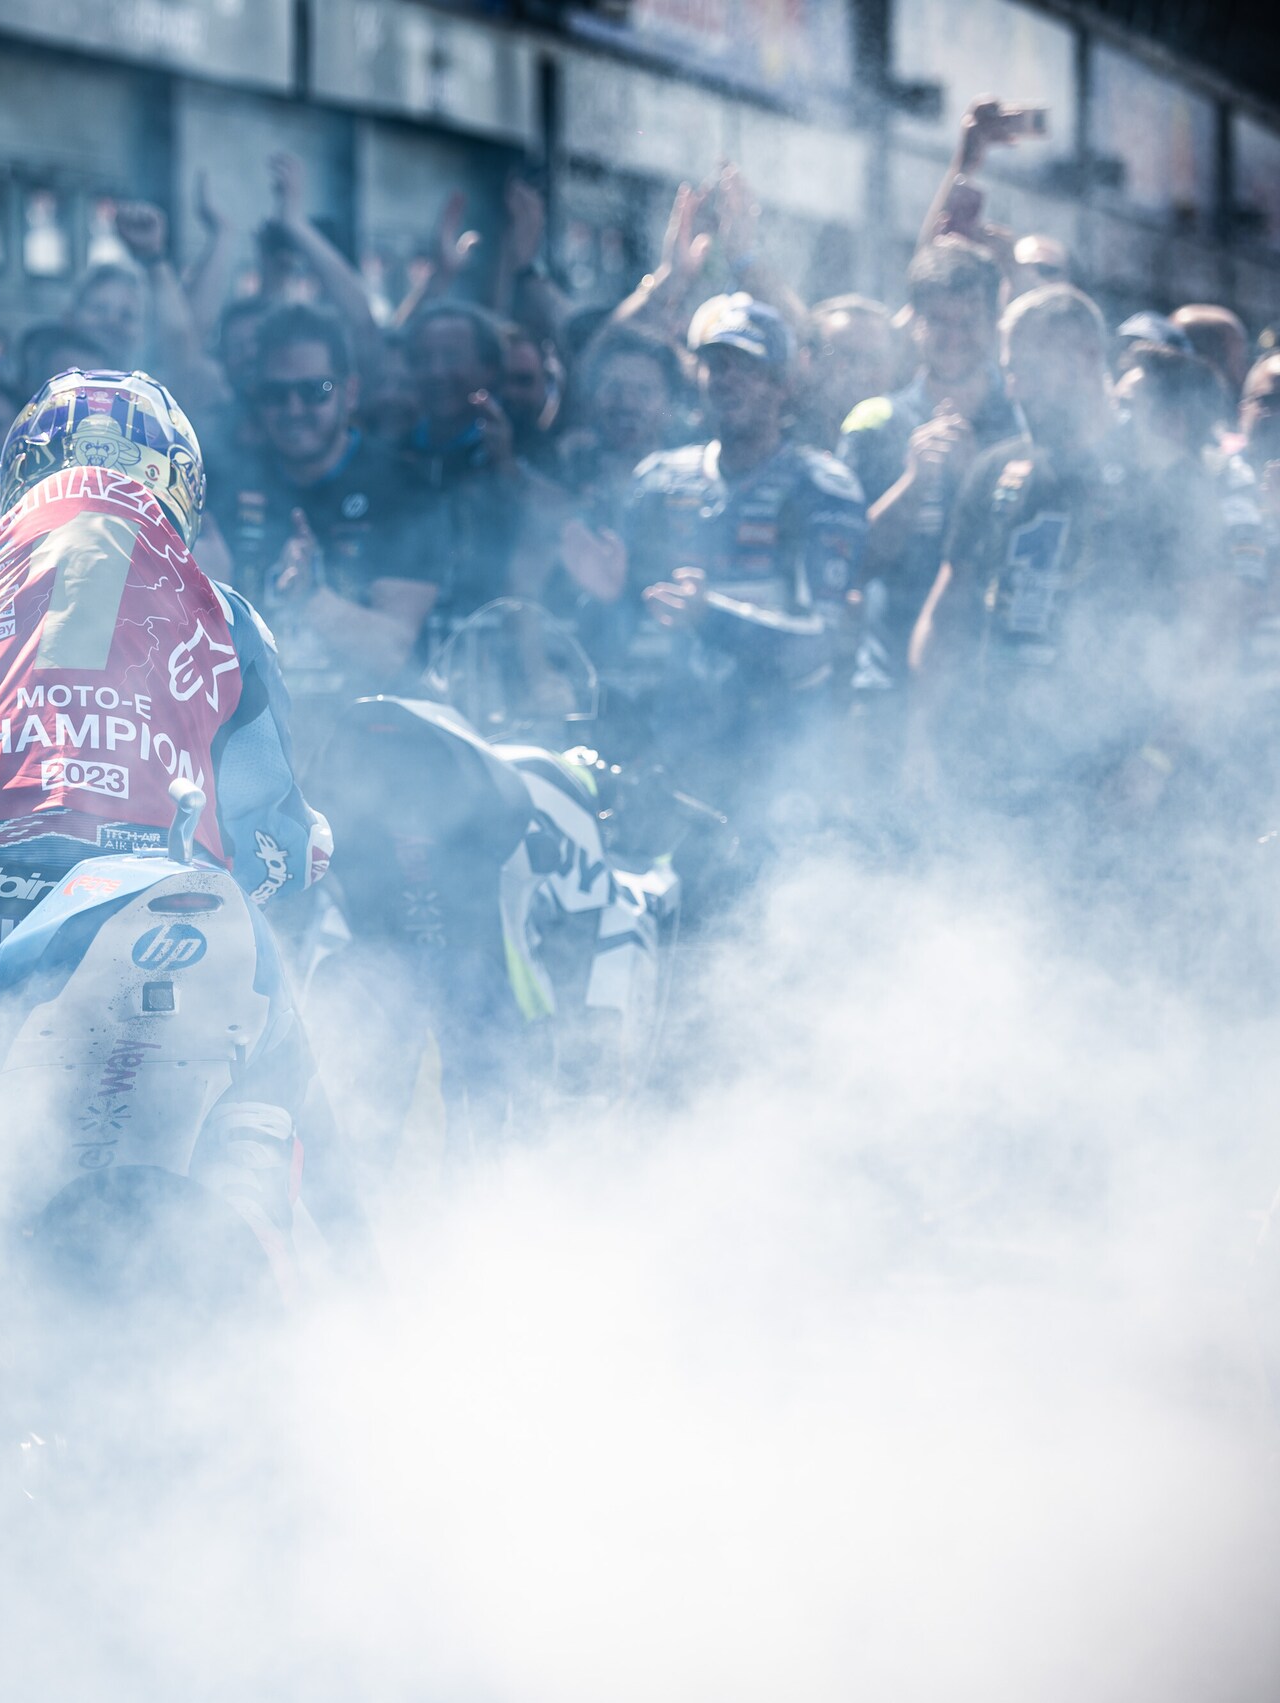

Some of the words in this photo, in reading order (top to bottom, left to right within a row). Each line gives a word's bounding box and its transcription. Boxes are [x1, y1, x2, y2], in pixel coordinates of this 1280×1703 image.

[16, 684, 152, 720] MOTO-E
[45, 762, 126, 793] 2023
[138, 923, 203, 971] hp
